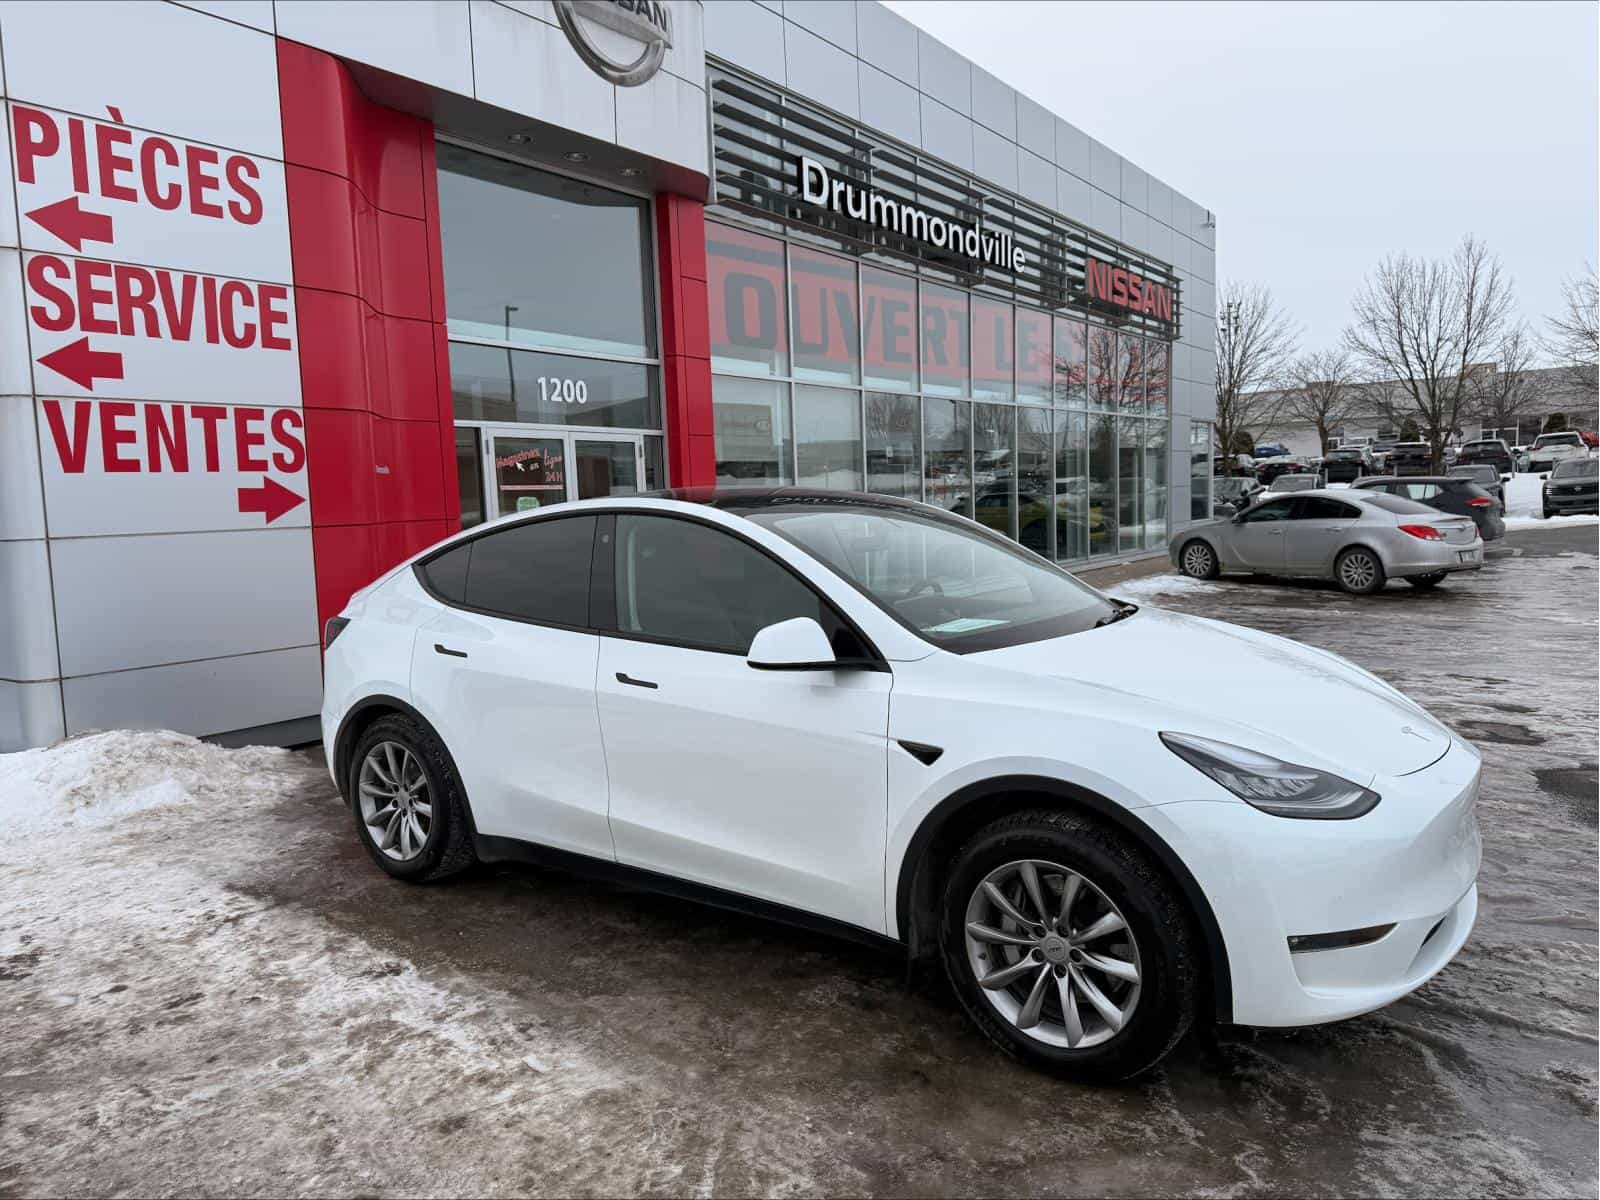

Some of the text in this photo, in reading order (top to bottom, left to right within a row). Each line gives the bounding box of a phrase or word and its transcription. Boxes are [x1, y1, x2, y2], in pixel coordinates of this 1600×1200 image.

[12, 105, 263, 225] PIÈCES
[801, 155, 1026, 272] Drummondville
[27, 255, 292, 351] SERVICE
[723, 271, 975, 369] OUVERT
[1087, 257, 1172, 321] NISSAN
[42, 399, 306, 474] VENTES
[537, 376, 588, 403] 1200
